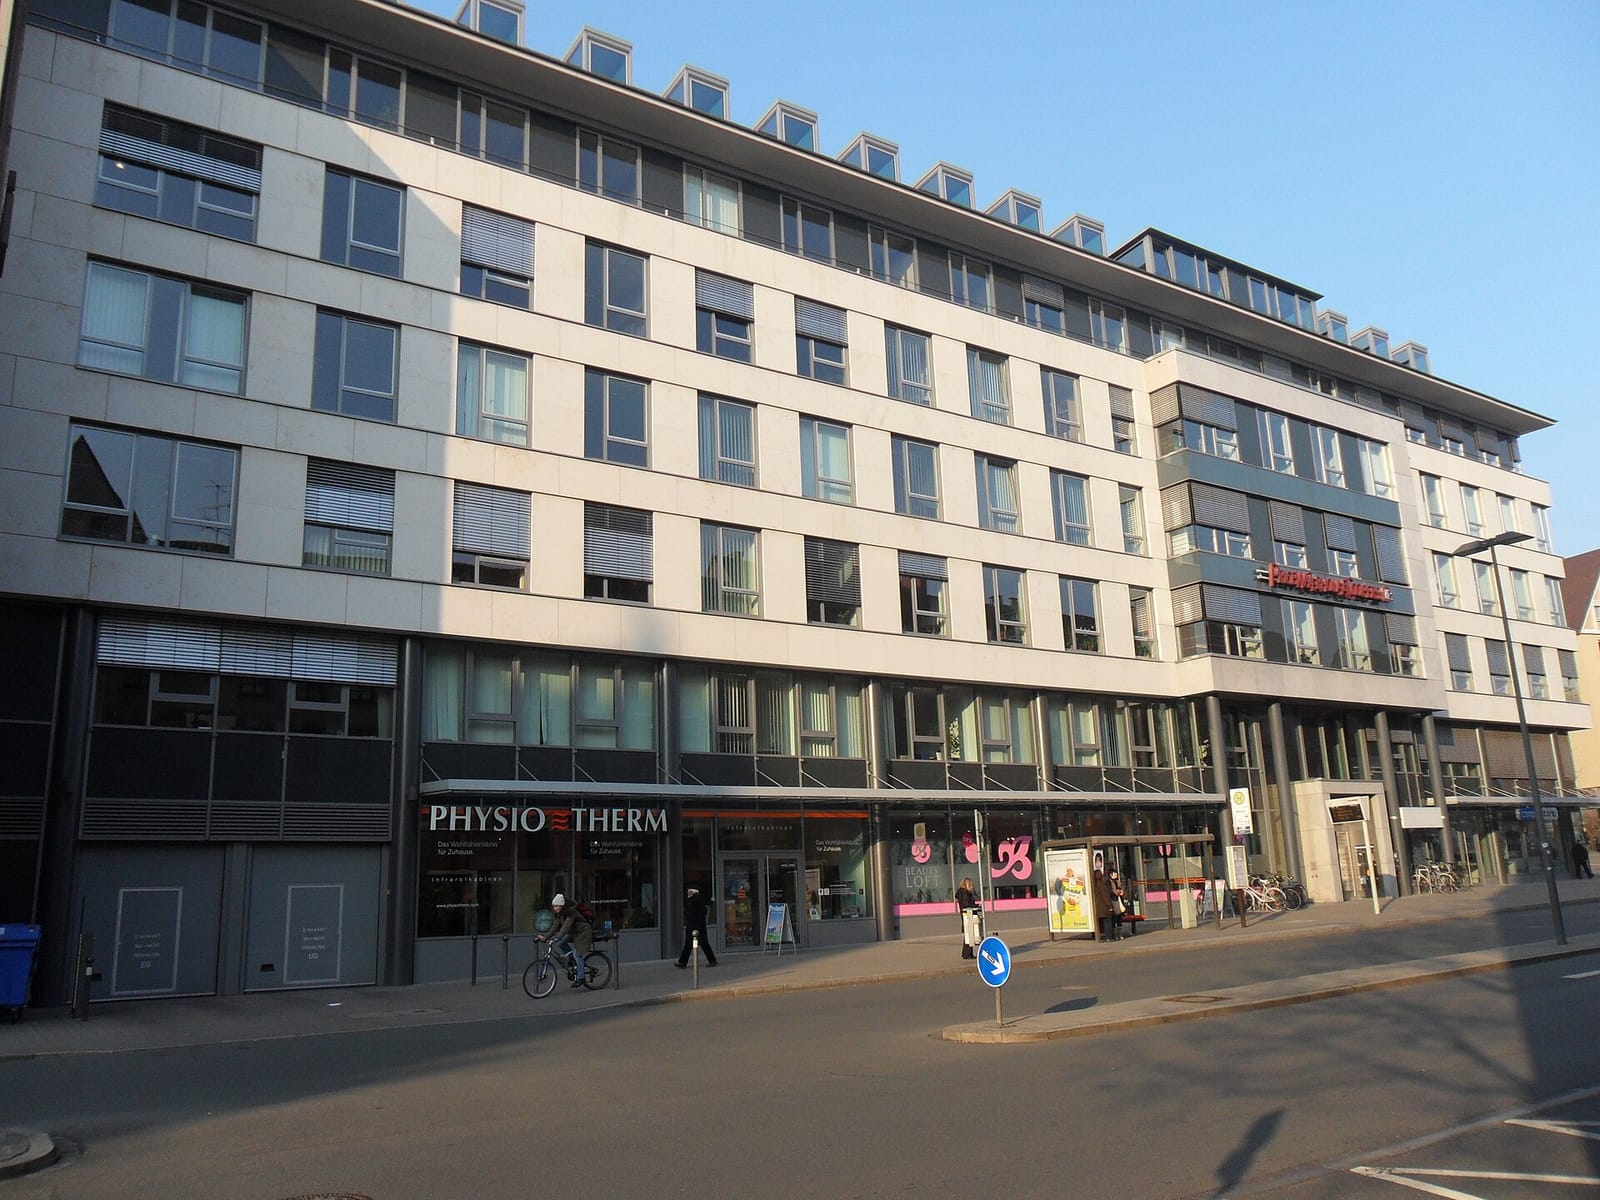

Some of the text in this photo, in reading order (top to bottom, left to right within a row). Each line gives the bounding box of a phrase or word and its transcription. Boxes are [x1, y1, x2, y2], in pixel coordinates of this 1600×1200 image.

[430, 805, 668, 832] PHYSIO THERM
[905, 875, 940, 888] LOFT
[140, 960, 152, 969] EG
